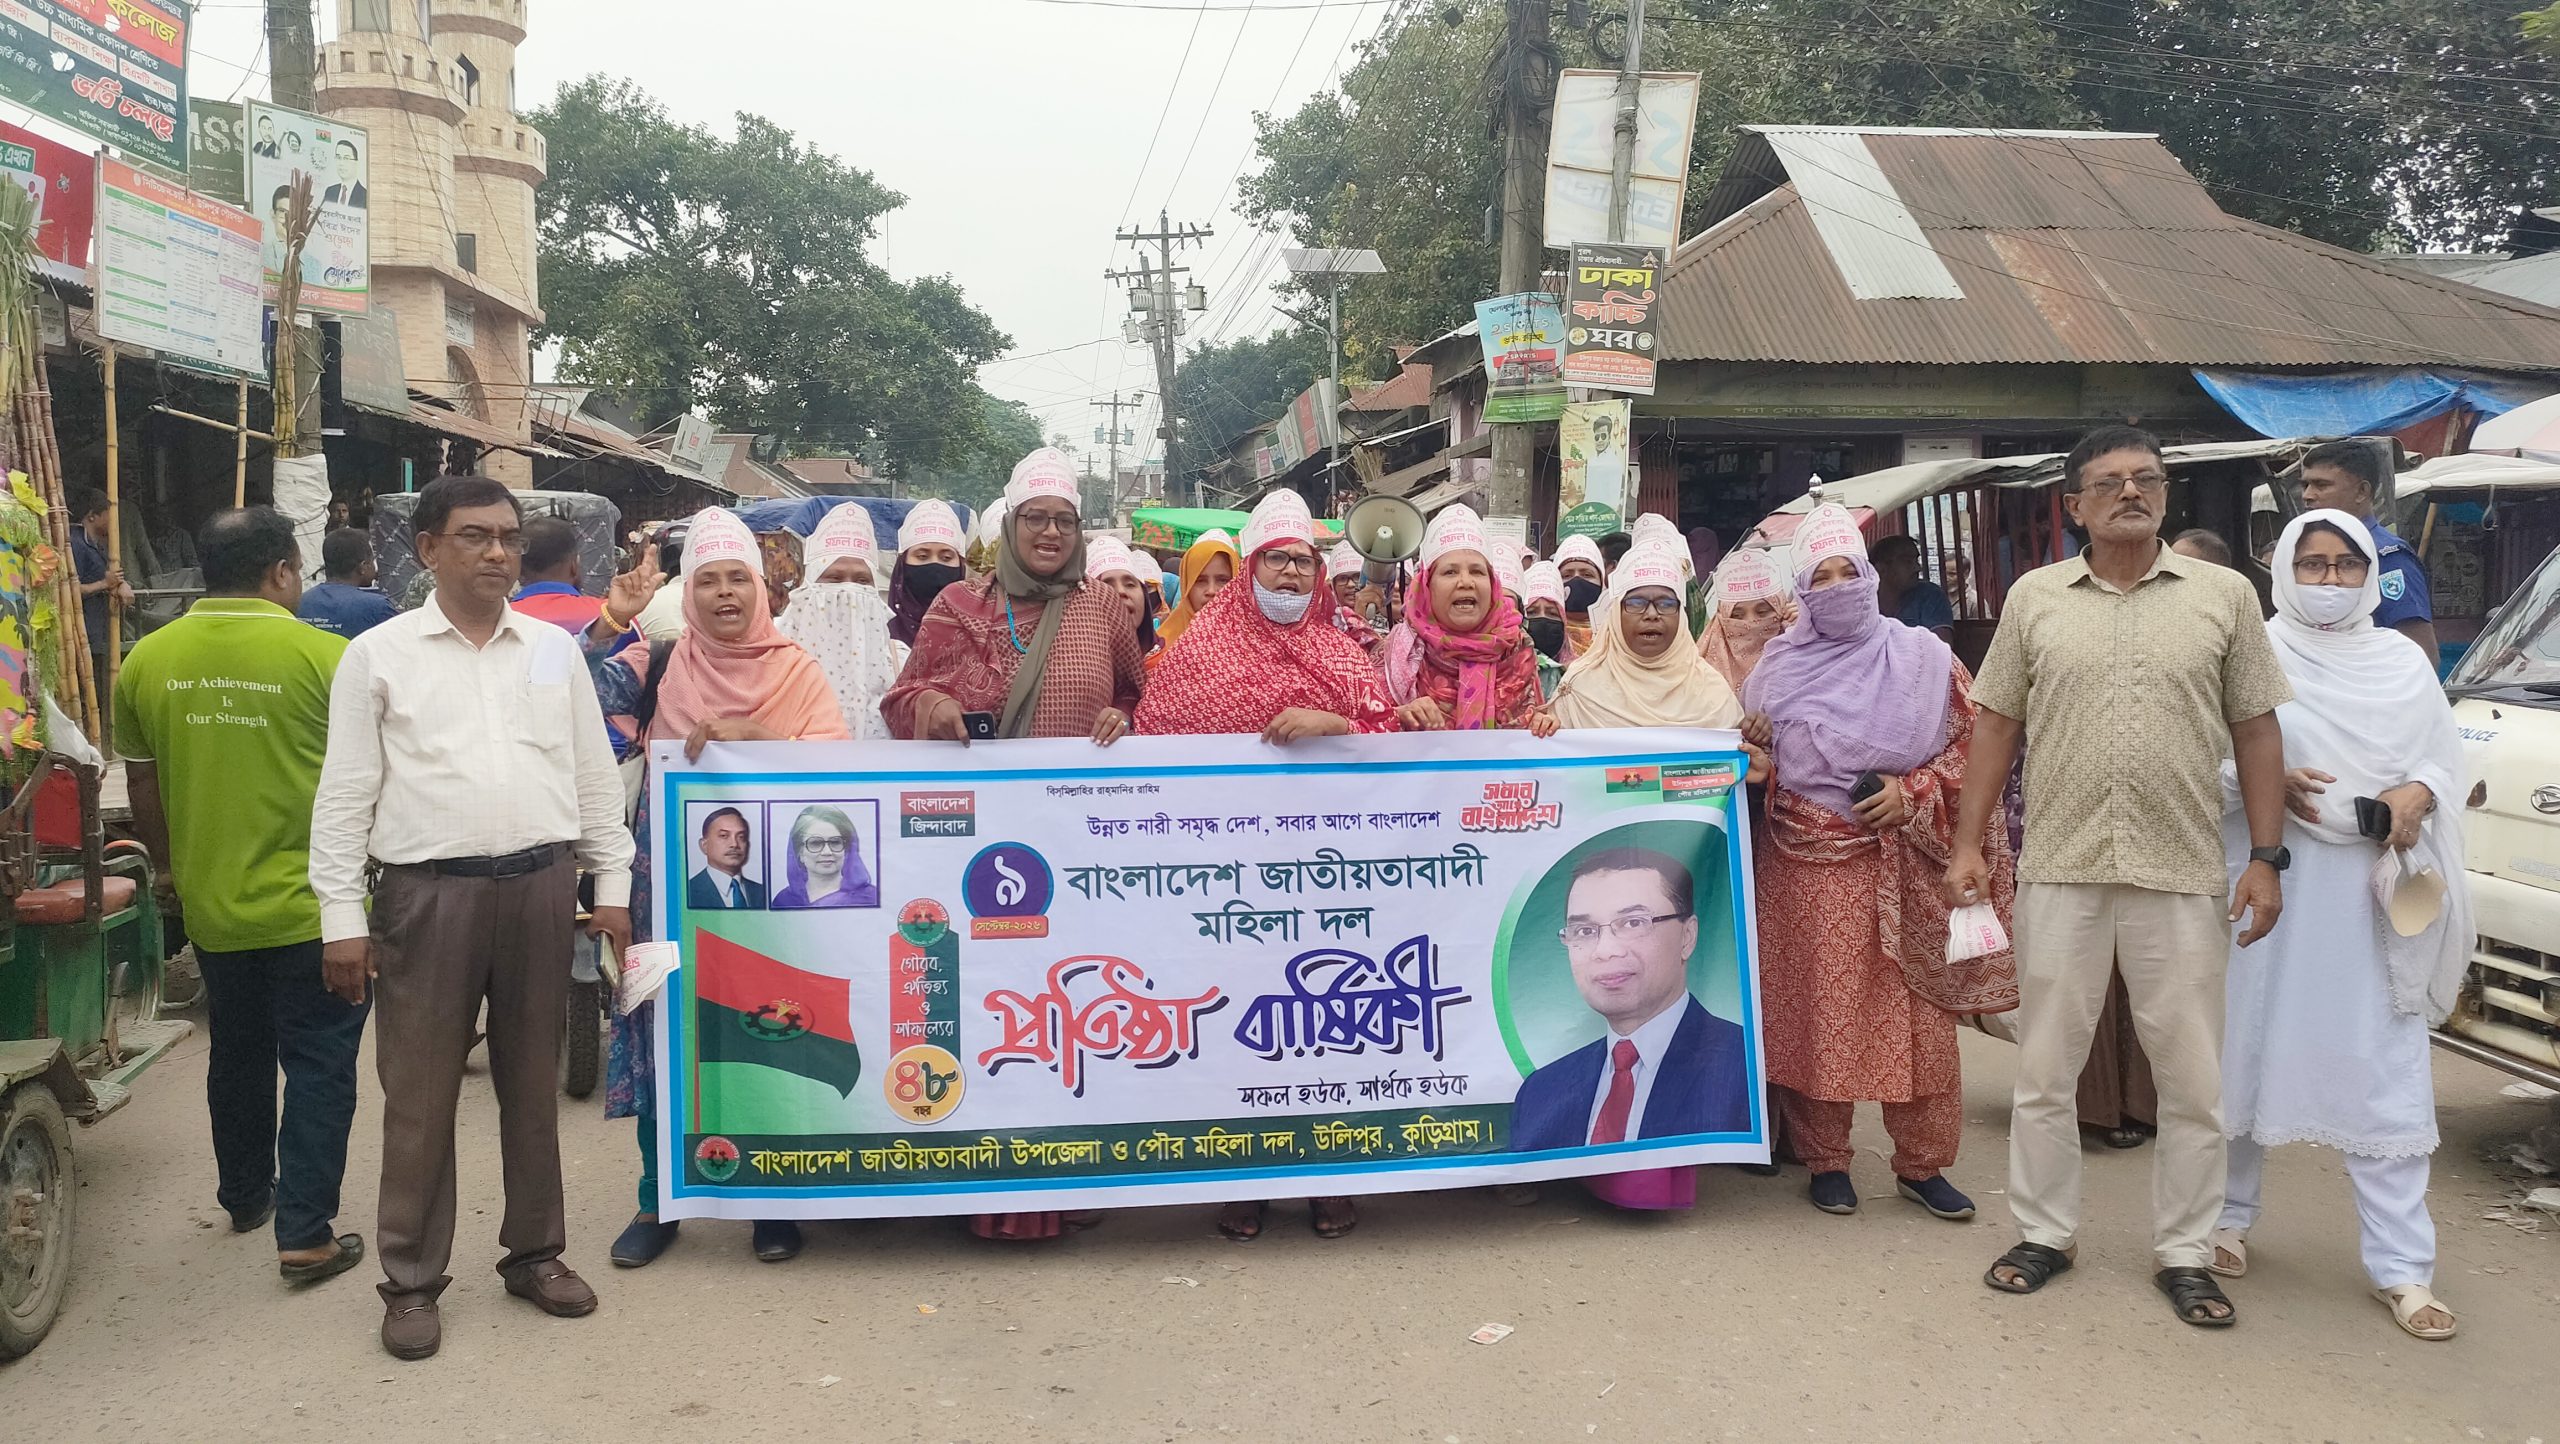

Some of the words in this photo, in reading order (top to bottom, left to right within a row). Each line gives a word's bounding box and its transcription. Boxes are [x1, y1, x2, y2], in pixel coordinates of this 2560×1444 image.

[71, 73, 124, 109] ভর্তি
[118, 95, 177, 143] চলছে
[1578, 267, 1653, 290] ঢাকা
[1572, 290, 1656, 324] কাচ্চি
[1588, 328, 1638, 350] ঘর
[1028, 477, 1056, 489] সফল
[694, 540, 720, 557] সফল
[825, 536, 851, 548] সফল
[1440, 533, 1465, 546] সফল
[1809, 536, 1836, 553] সফল
[1633, 567, 1660, 578] সফল
[1727, 582, 1751, 592] সফল
[166, 678, 195, 691] Our
[198, 676, 283, 694] Achievement
[222, 695, 233, 707] Is
[185, 712, 212, 725] Our
[215, 711, 268, 728] Strength
[2456, 727, 2499, 742] OLICE
[1136, 783, 1160, 795] রাহিম
[906, 796, 970, 812] বাংলাদেশ
[908, 816, 968, 835] জিন্দাবাদ
[1086, 814, 1131, 839] উন্নত
[1135, 812, 1172, 836] নারী
[1177, 817, 1220, 841] সমৃদ্ধ
[1226, 814, 1270, 836] দেশ,
[1276, 811, 1316, 833] সবার
[1322, 810, 1362, 831] আগে
[1367, 809, 1441, 832] বাংলাদেশ
[994, 855, 1027, 906] ৯
[1064, 858, 1246, 901] বাংলাদেশ
[1256, 841, 1488, 895] জাতীয়তাবাদী
[1194, 900, 1303, 944] মহিলা
[1314, 904, 1375, 941] দল
[900, 953, 943, 975] গৌরব,
[901, 976, 949, 996] ঐতিহ্য
[918, 1001, 931, 1016] ও
[977, 953, 1230, 1098] প্রতিষ্ঠা
[1233, 933, 1472, 1063] বার্ষিকী
[892, 1018, 956, 1039] সাফল্যের
[894, 1060, 958, 1103] ৪৮
[1238, 1085, 1290, 1110] সফল
[1359, 1075, 1412, 1104] সার্থক
[1419, 1073, 1468, 1098] হউক
[912, 1105, 932, 1117] বছর
[749, 1147, 852, 1177] বাংলাদেশ
[859, 1136, 1002, 1174] জাতীয়তাবাদী
[1010, 1136, 1102, 1167] উপজেলা
[1109, 1141, 1129, 1163] ও
[1135, 1132, 1187, 1162] পৌর
[1194, 1125, 1253, 1160] মহিলা
[1262, 1130, 1308, 1160] দল,
[1312, 1122, 1394, 1154] উলিপুর,
